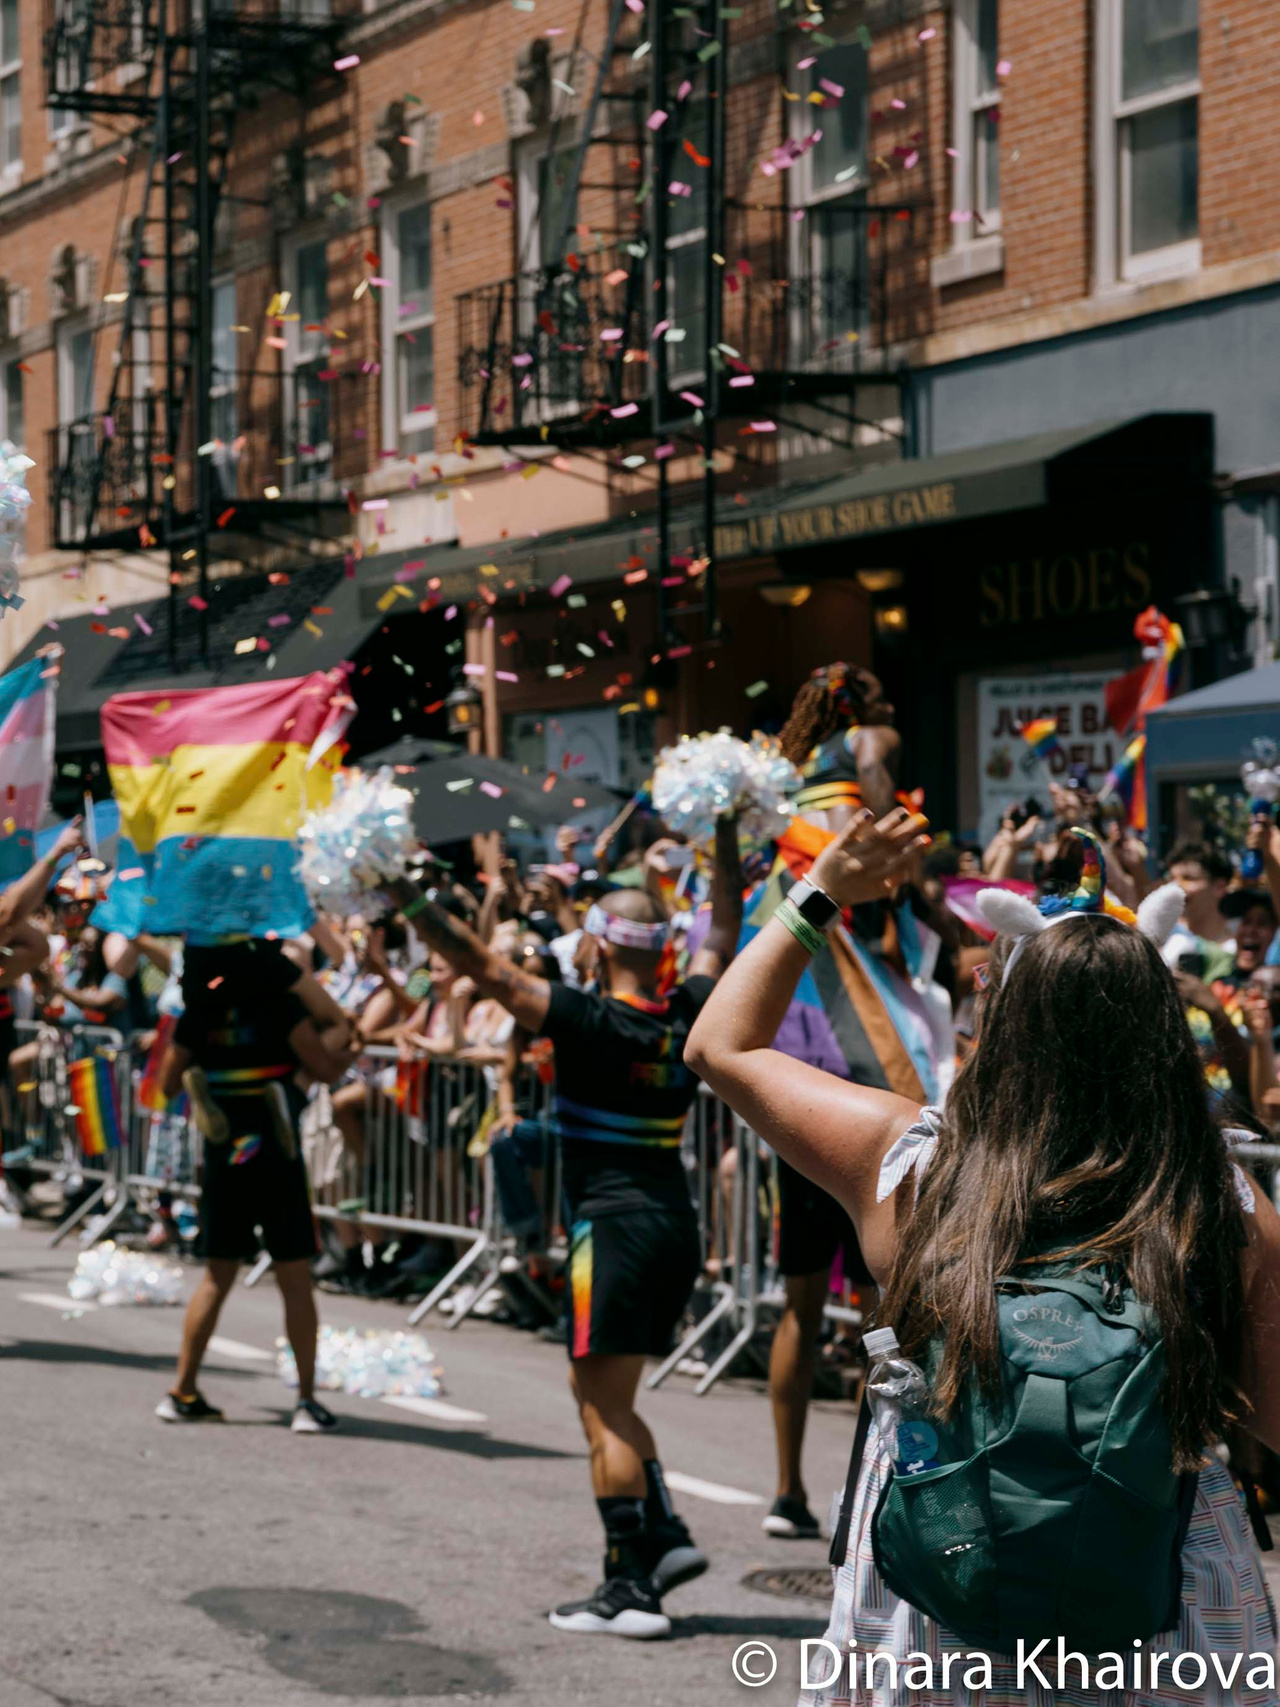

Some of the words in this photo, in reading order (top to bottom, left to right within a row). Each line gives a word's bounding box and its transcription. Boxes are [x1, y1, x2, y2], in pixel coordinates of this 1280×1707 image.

[780, 505, 834, 544] YOUR
[835, 494, 892, 537] SHOE
[893, 483, 956, 525] GAME
[979, 543, 1151, 626] SHOES
[1012, 1306, 1084, 1333] OSPREY
